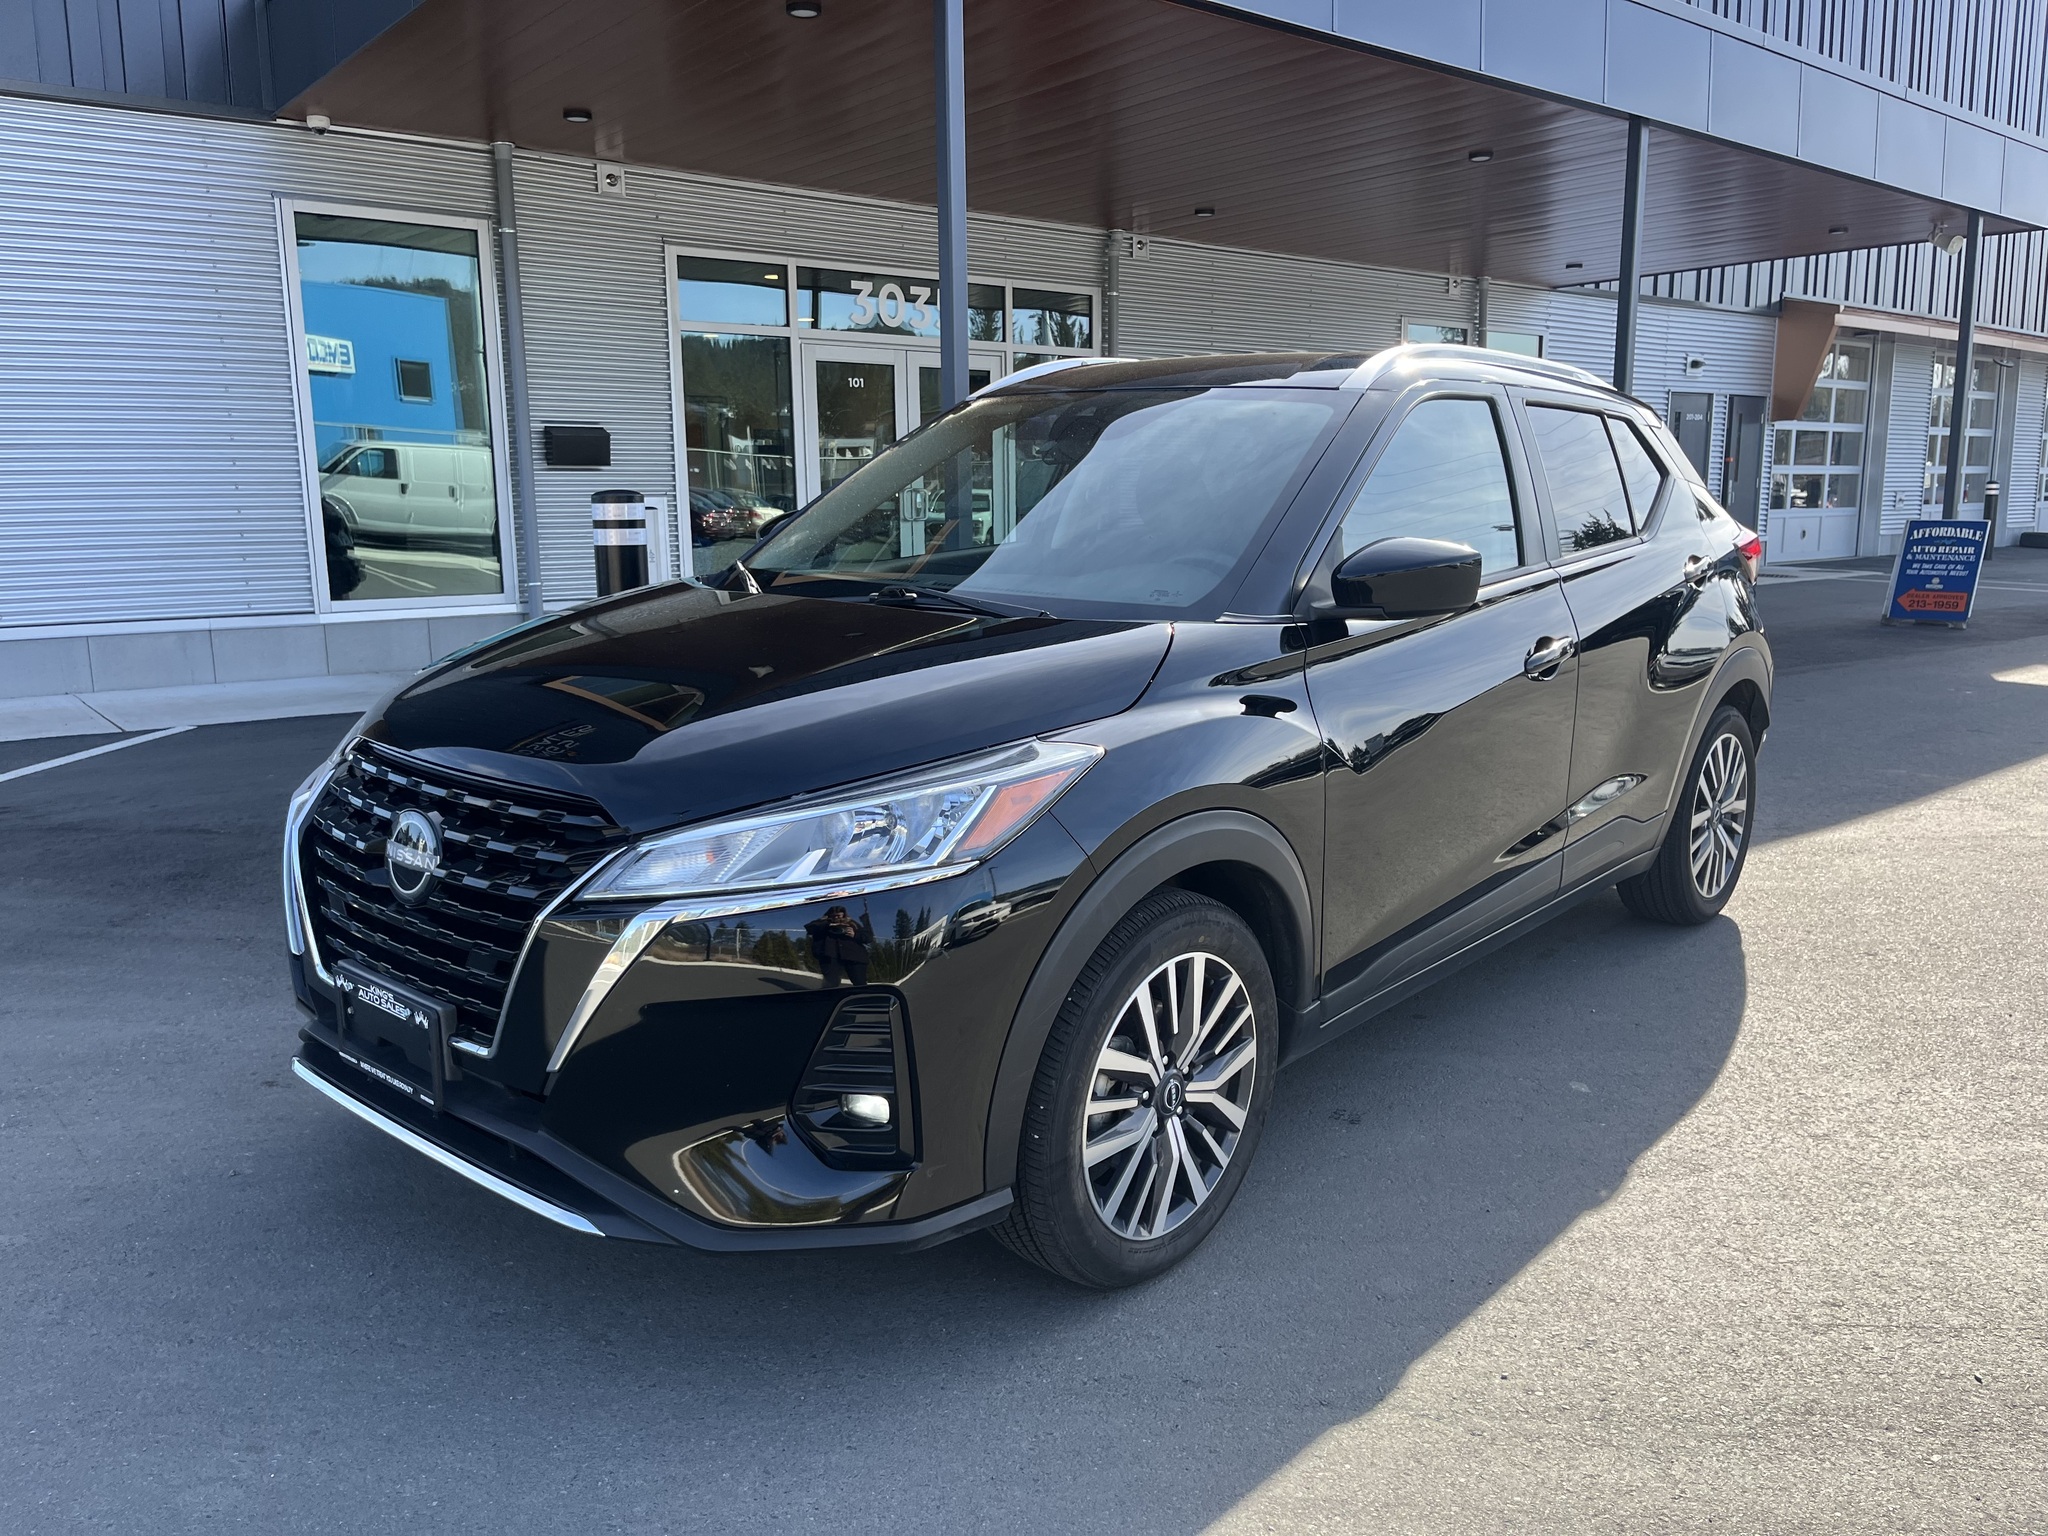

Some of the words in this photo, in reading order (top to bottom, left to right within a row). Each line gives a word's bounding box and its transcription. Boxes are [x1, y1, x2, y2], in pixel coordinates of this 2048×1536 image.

[851, 280, 940, 328] 303
[848, 378, 864, 388] 101
[1910, 527, 1984, 541] AFFORDABLE
[1911, 545, 1936, 553] AUTO
[1938, 546, 1975, 554] REPAIR
[1914, 554, 1976, 562] MAINTENANCE
[1908, 600, 1959, 610] 213-1959
[387, 841, 436, 870] NISSAN
[369, 985, 394, 1002] KING'S
[358, 989, 380, 1004] AUTO
[381, 999, 405, 1017] SALES
